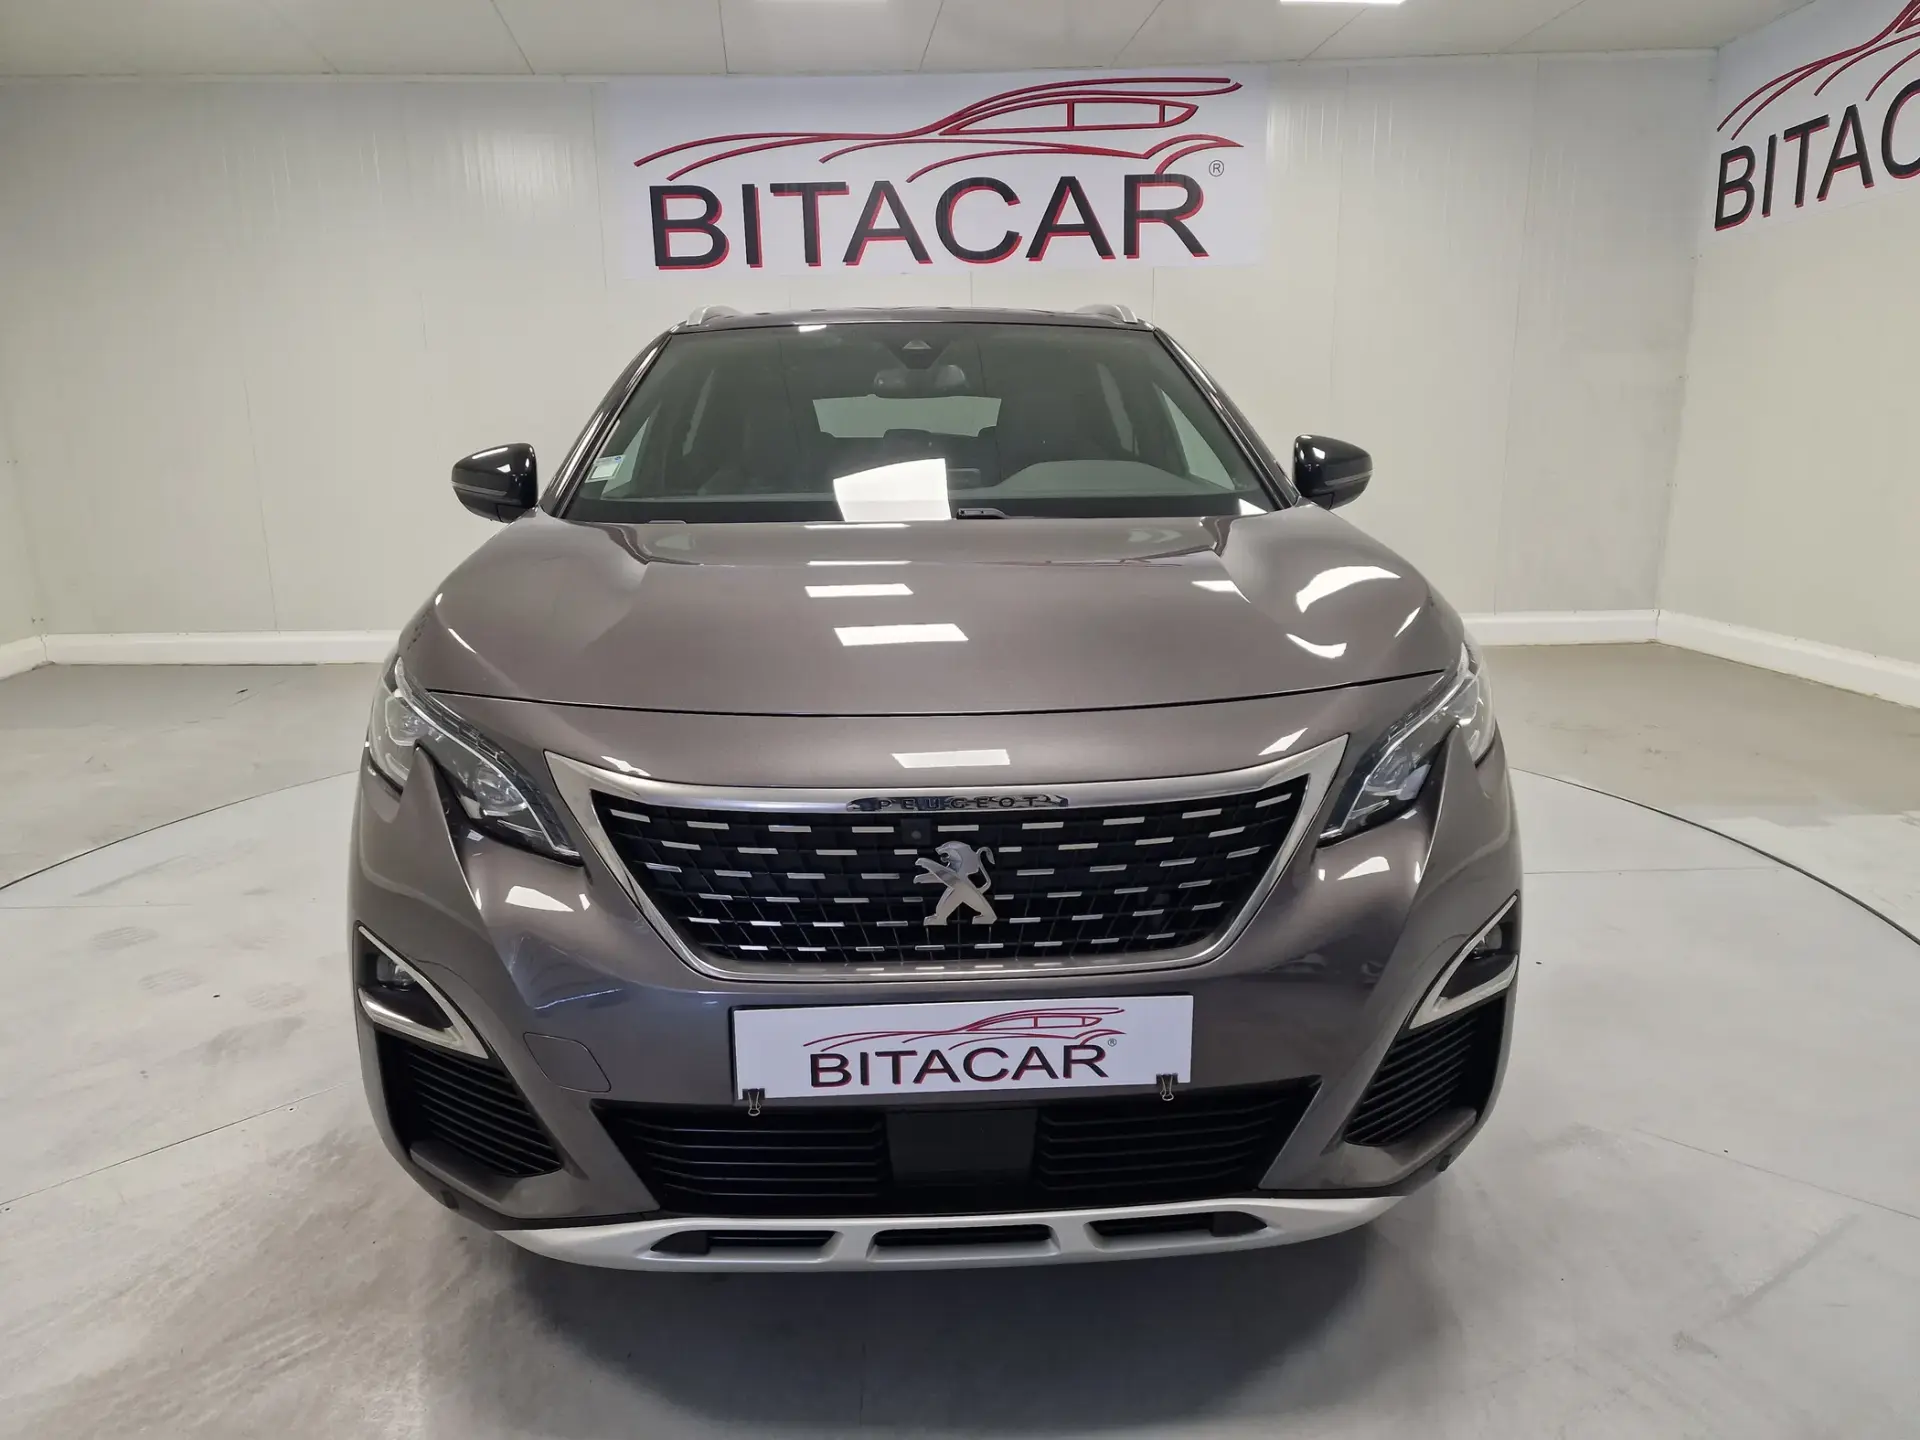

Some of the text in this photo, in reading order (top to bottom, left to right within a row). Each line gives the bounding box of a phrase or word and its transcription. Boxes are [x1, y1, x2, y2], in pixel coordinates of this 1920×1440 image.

[649, 173, 1210, 270] BITACAR
[877, 796, 1034, 811] PEUGEOT
[809, 1044, 1109, 1088] BITACAR
